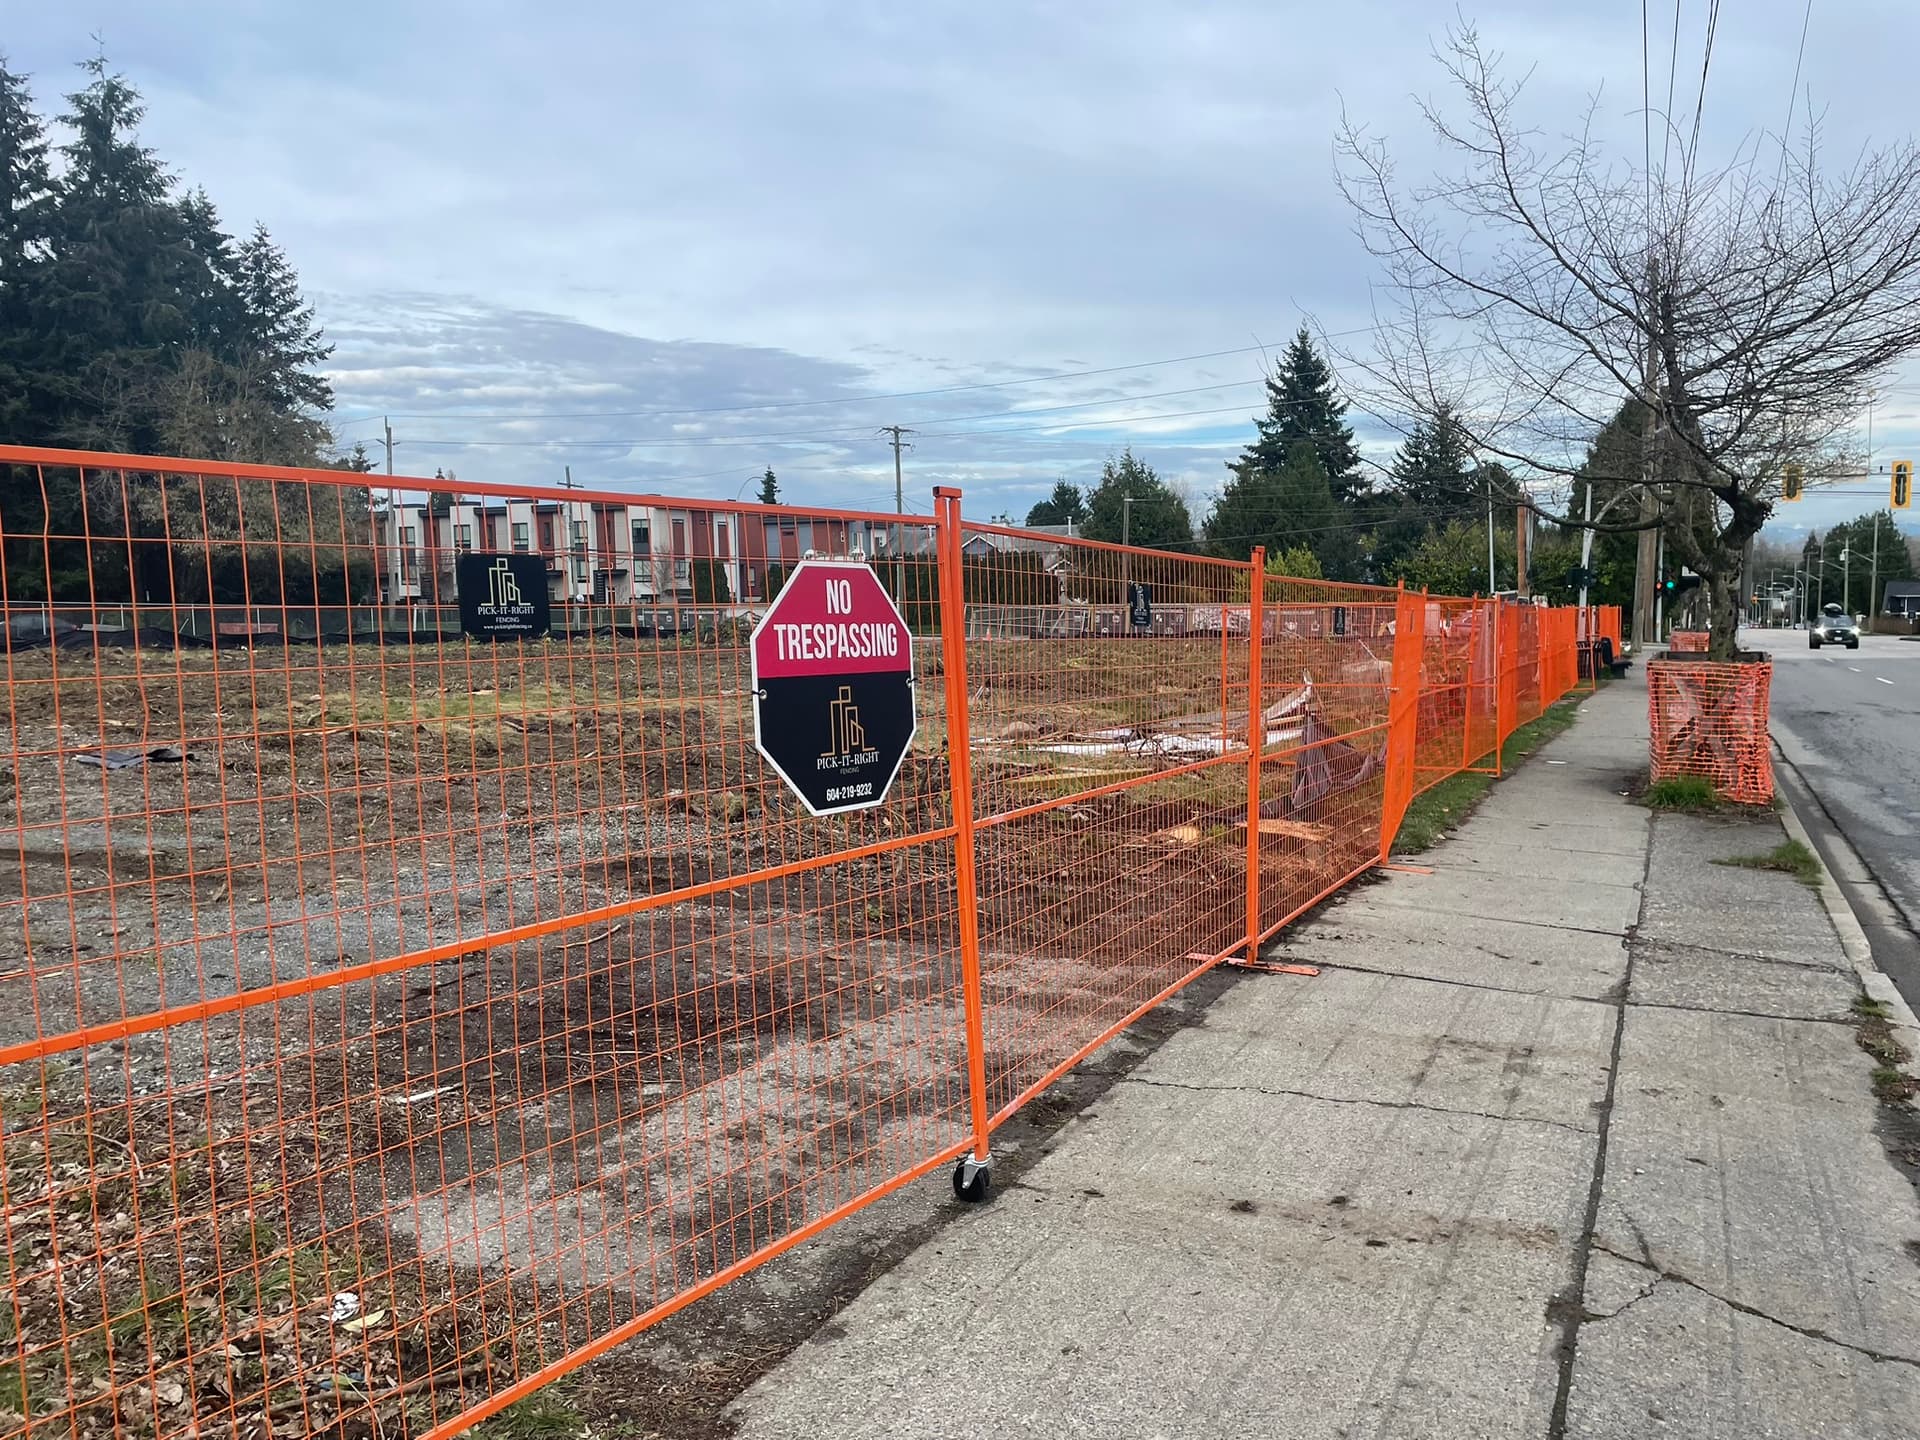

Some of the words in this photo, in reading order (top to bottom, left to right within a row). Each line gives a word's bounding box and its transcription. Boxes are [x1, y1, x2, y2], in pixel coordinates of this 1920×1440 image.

[826, 579, 851, 615] NO
[477, 606, 535, 615] PICK-IT-RIGHT
[773, 623, 898, 661] TRESPASSING
[816, 751, 880, 770] PICK-IT-RIGHT
[826, 782, 873, 802] 604-219-9232
